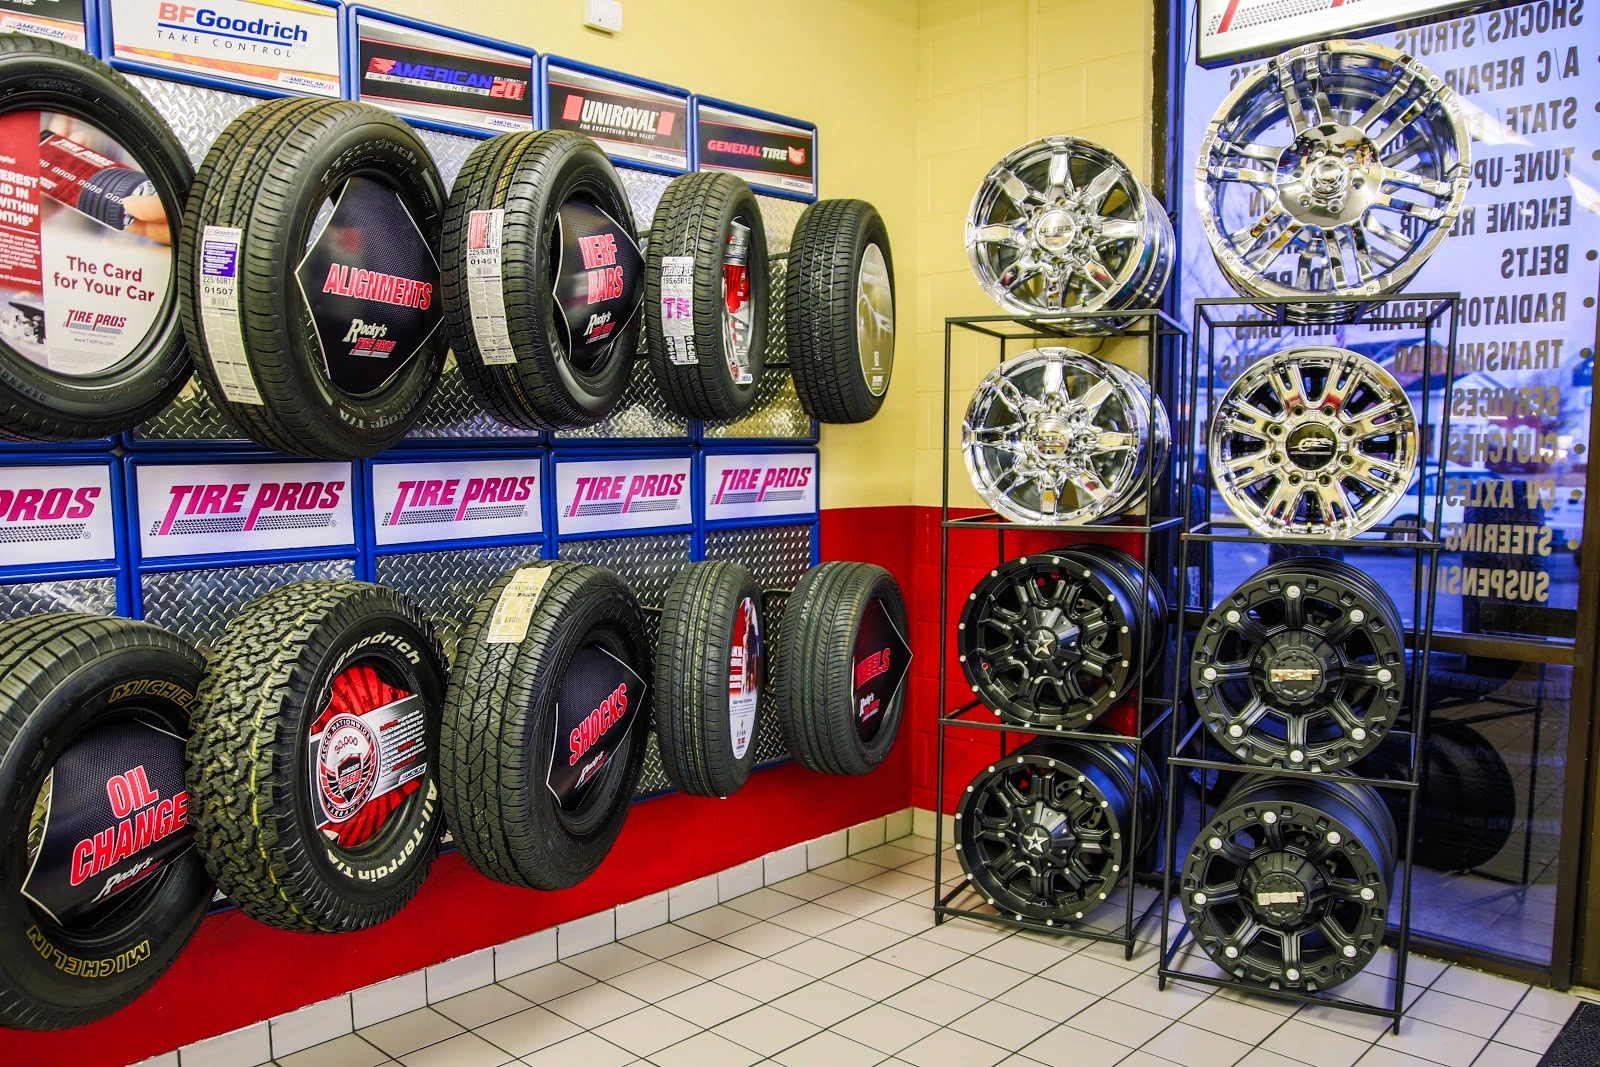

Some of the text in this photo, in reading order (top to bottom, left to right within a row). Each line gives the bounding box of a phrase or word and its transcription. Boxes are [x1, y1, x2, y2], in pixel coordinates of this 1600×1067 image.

[158, 1, 308, 42] BFGoodrich
[157, 30, 291, 58] TAKE CONTROL
[369, 73, 488, 95] CAR CARE CENTERS
[388, 61, 527, 99] AMERICAN 20
[581, 99, 657, 133] UNIROYAL
[592, 125, 626, 136] EVERYTHING
[627, 130, 638, 138] YOU
[50, 138, 84, 153] TIRE
[707, 139, 762, 157] GENERAL
[762, 147, 788, 161] TIRE
[16, 187, 29, 200] IN
[67, 255, 142, 283] The Card
[578, 233, 618, 270] NERF
[53, 271, 155, 302] for Your Car
[204, 286, 234, 296] 01507
[322, 263, 432, 310] ALIGNMENTS
[587, 265, 624, 305] BARS
[65, 309, 127, 331] TIRE PROS
[342, 318, 388, 344] Rocky's
[389, 476, 536, 526] TIRE PROS
[568, 473, 687, 518] TIRE PROS
[715, 467, 811, 505] TIRE PROS
[157, 481, 345, 536] TIRE PROS
[108, 679, 201, 716] MICHEL
[331, 718, 372, 741] NATIONWIDE
[569, 682, 628, 767] SHOCKS
[107, 765, 159, 819] OIL
[70, 790, 191, 887] CHANGE
[328, 779, 438, 883] All-Terrain T/A
[91, 856, 154, 904] Rocky's
[26, 924, 151, 979] MICHELIN
